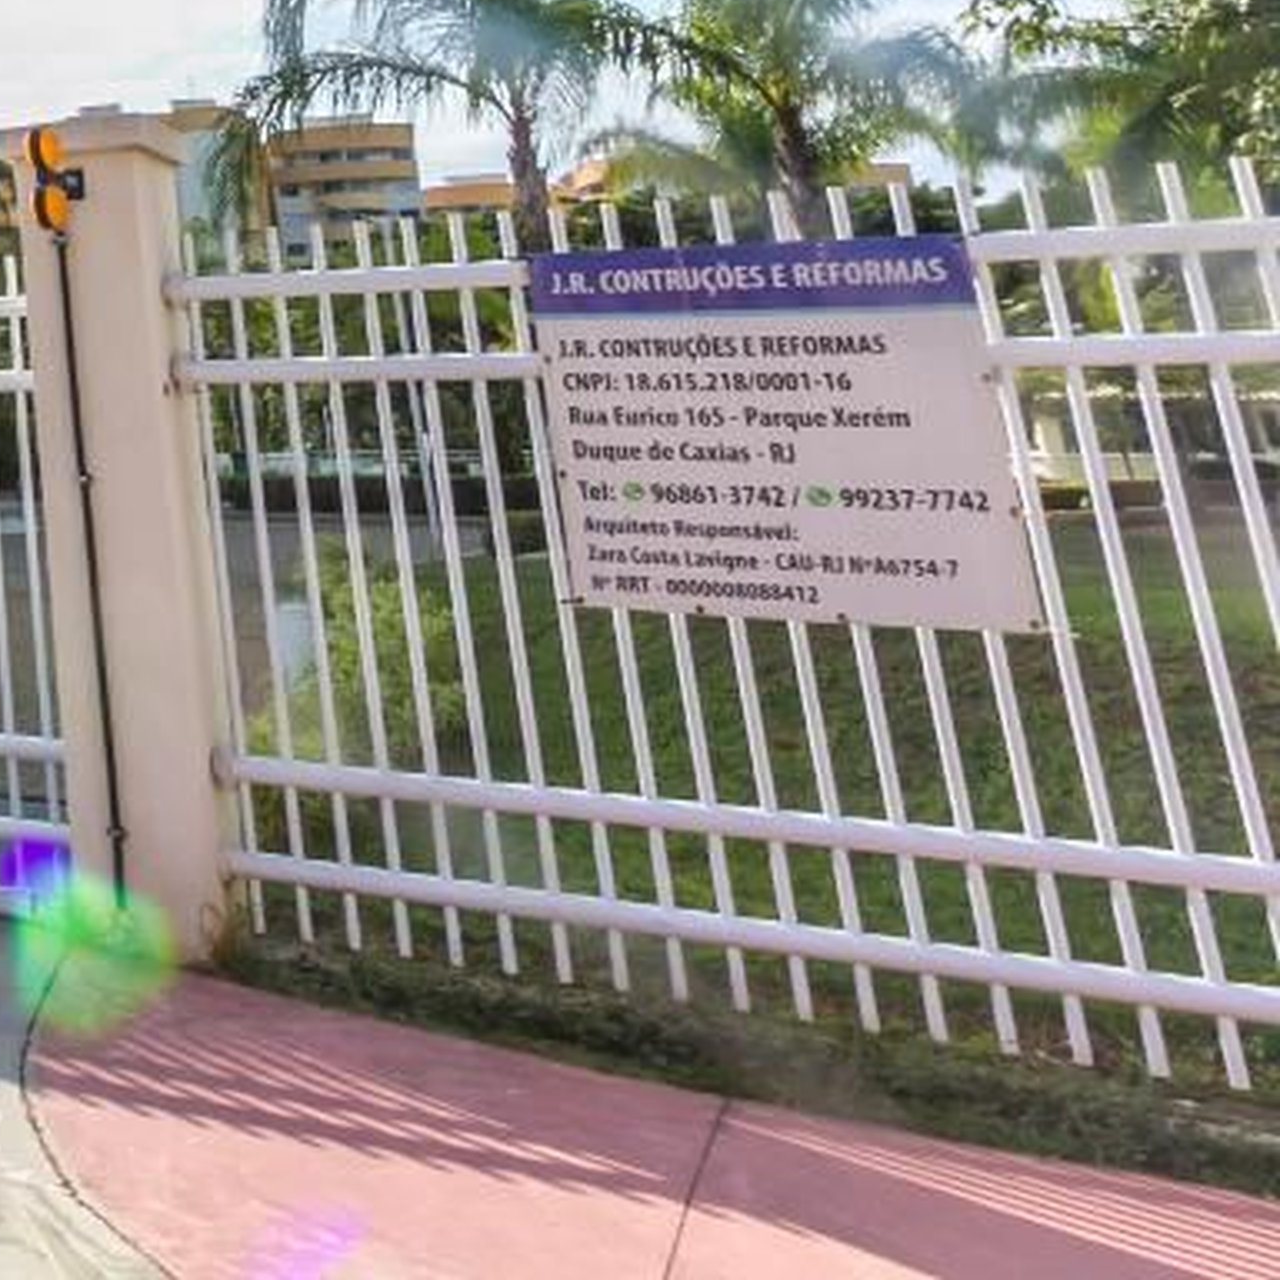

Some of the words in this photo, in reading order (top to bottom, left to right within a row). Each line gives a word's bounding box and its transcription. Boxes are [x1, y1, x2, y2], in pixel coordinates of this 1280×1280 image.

[550, 272, 595, 295] J.R.
[599, 261, 765, 298] CONTRUÇÕES
[771, 264, 789, 288] E
[794, 257, 948, 288] REFORMAS
[558, 339, 595, 358] J.R.
[598, 333, 737, 362] CONTRUÇÕES
[743, 336, 756, 357] E
[759, 334, 888, 357] REFORMAS
[562, 372, 619, 392] CNPJ:
[568, 405, 609, 425] Rua
[613, 405, 680, 426] Eurico
[685, 406, 725, 427] 165
[744, 406, 828, 432] Parque
[832, 406, 912, 428] Xerém
[572, 439, 642, 464] Duque
[647, 441, 675, 462] de
[679, 441, 751, 464] Caxias
[769, 442, 796, 465] RJ
[576, 480, 617, 502] Tel:
[650, 482, 786, 508] 96861-3742
[839, 488, 991, 512] 99237-7742
[630, 546, 681, 567] Costa
